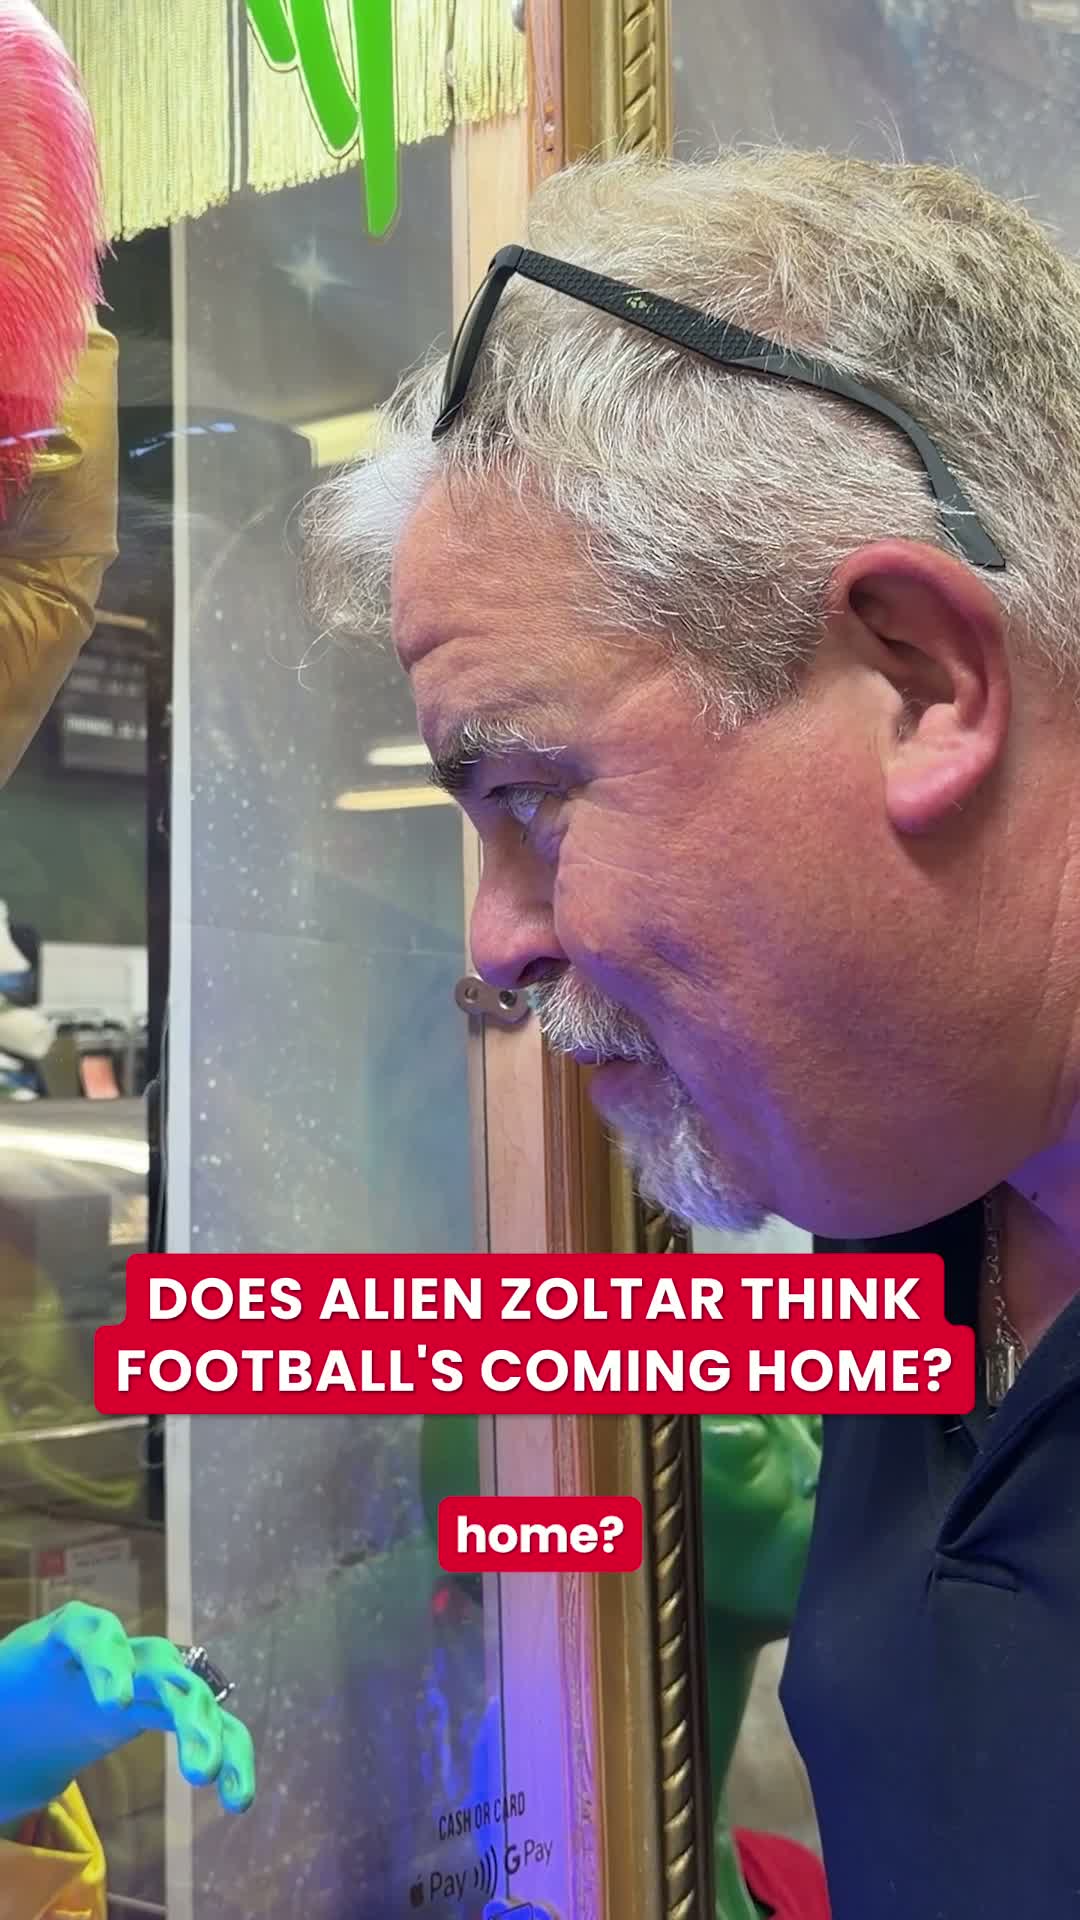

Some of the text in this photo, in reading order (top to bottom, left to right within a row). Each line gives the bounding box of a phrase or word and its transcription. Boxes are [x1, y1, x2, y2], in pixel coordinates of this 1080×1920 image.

[439, 1792, 525, 1840] CASH OR CARD
[523, 1839, 553, 1866] Pay
[429, 1871, 466, 1900] Pay
